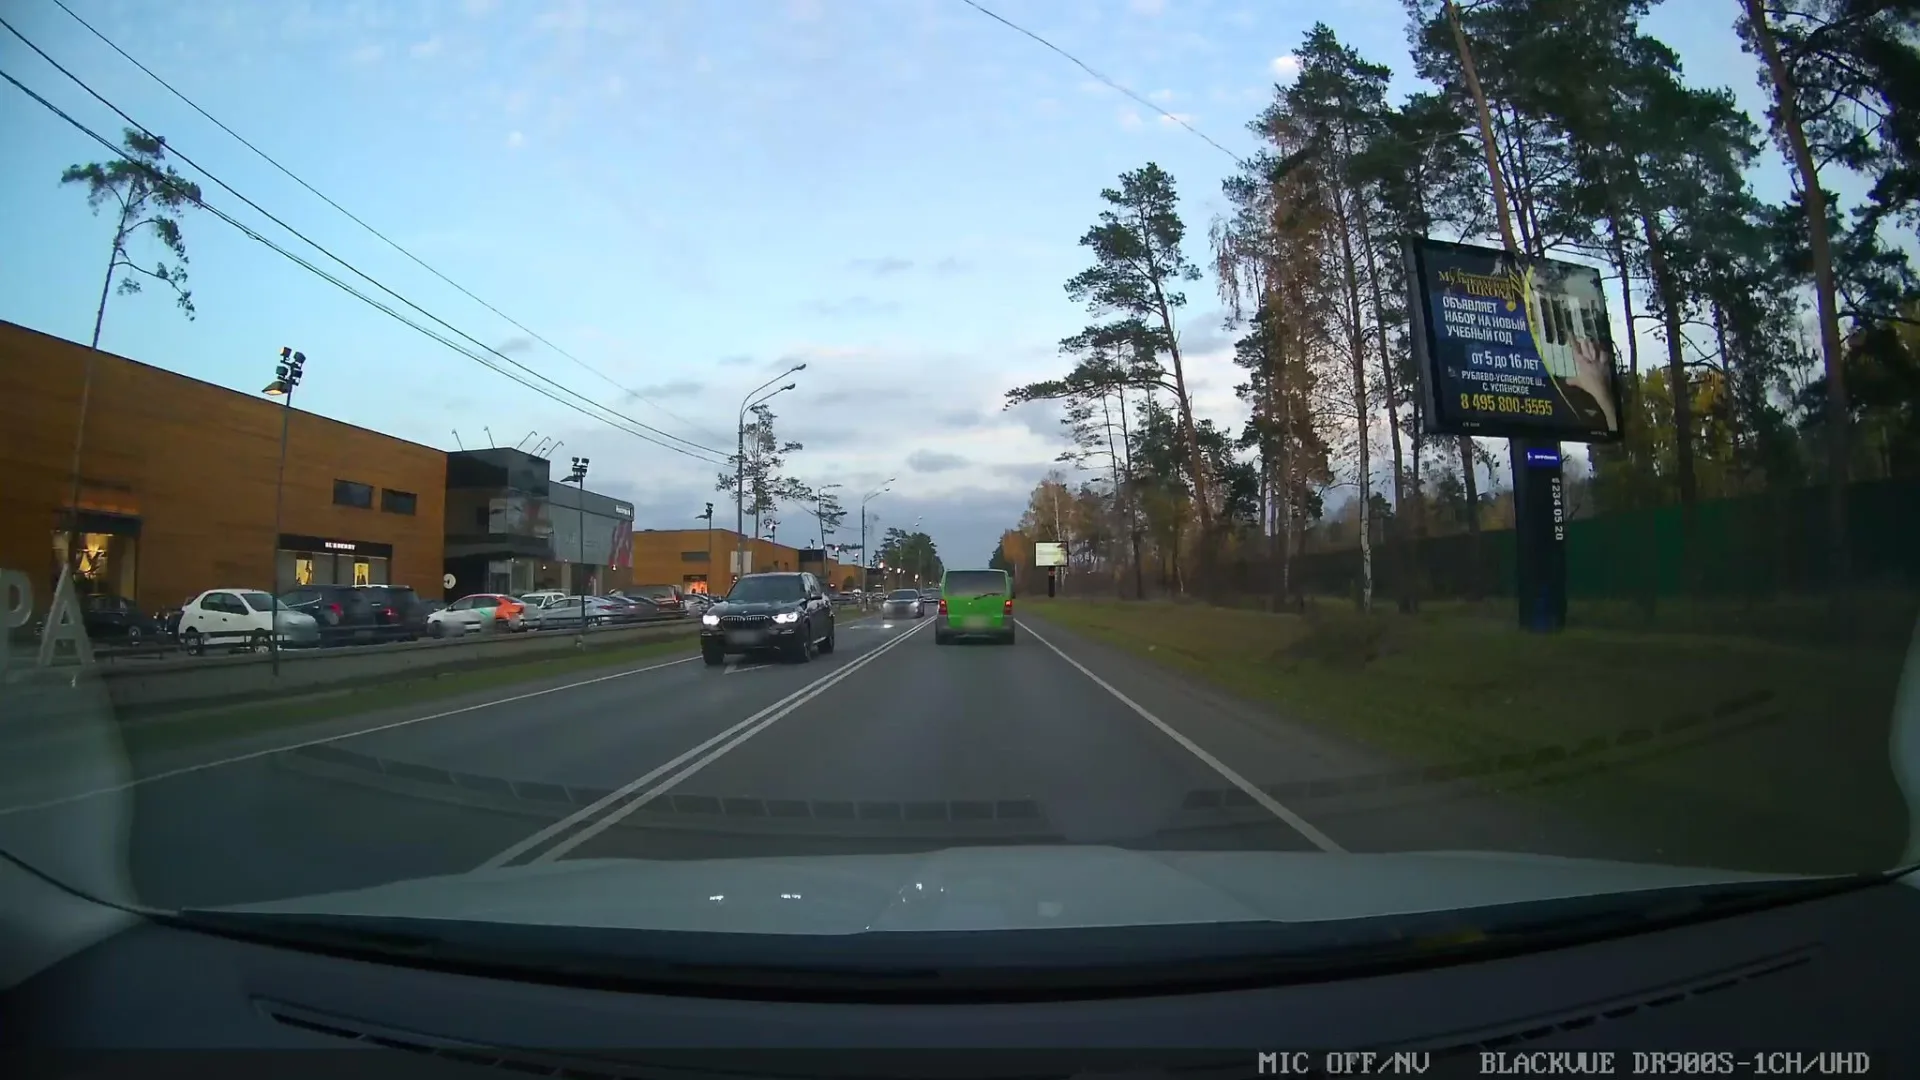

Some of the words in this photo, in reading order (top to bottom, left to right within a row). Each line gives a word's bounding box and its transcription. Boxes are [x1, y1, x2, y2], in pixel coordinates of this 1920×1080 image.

[1442, 296, 1498, 314] ОБЪЯВЛЯЕТ
[1444, 310, 1476, 325] НАБОР
[1477, 316, 1491, 327] НА
[1492, 316, 1527, 331] НОВЫЙ
[1446, 325, 1493, 342] УЧЕБНЫЙ
[1494, 331, 1513, 345] ГОД
[1484, 350, 1493, 366] 5
[1508, 353, 1522, 369] 16
[1490, 383, 1530, 395] УСПЕНСКОЕ
[1460, 393, 1469, 409] 8
[1472, 393, 1495, 411] 495
[1498, 396, 1553, 416] 800-5555
